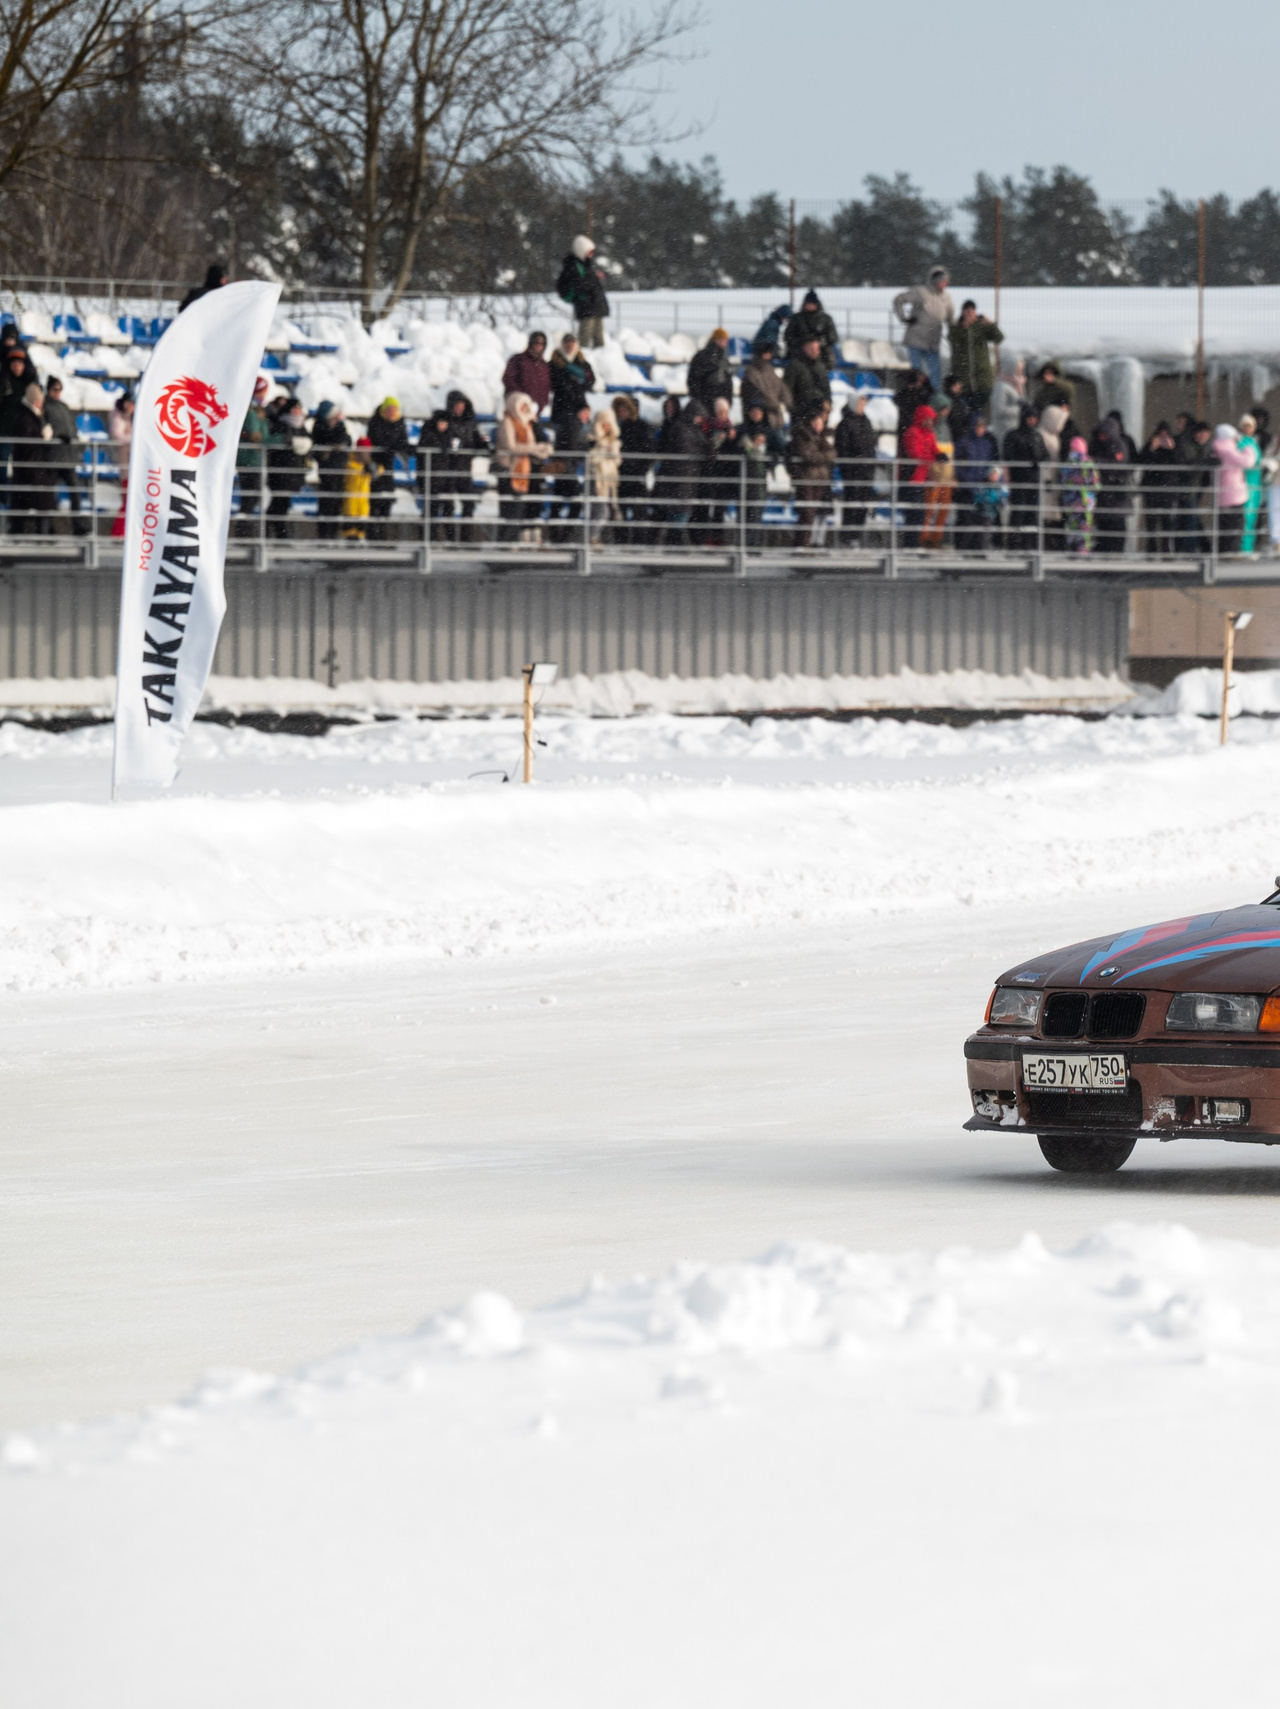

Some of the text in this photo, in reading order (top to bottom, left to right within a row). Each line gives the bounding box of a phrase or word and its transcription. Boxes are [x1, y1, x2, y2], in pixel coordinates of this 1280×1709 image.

[139, 466, 162, 571] MOTOR OIL
[142, 469, 200, 727] TAKAYAMA
[1091, 1057, 1120, 1077] 750
[1100, 1077, 1114, 1085] RUS
